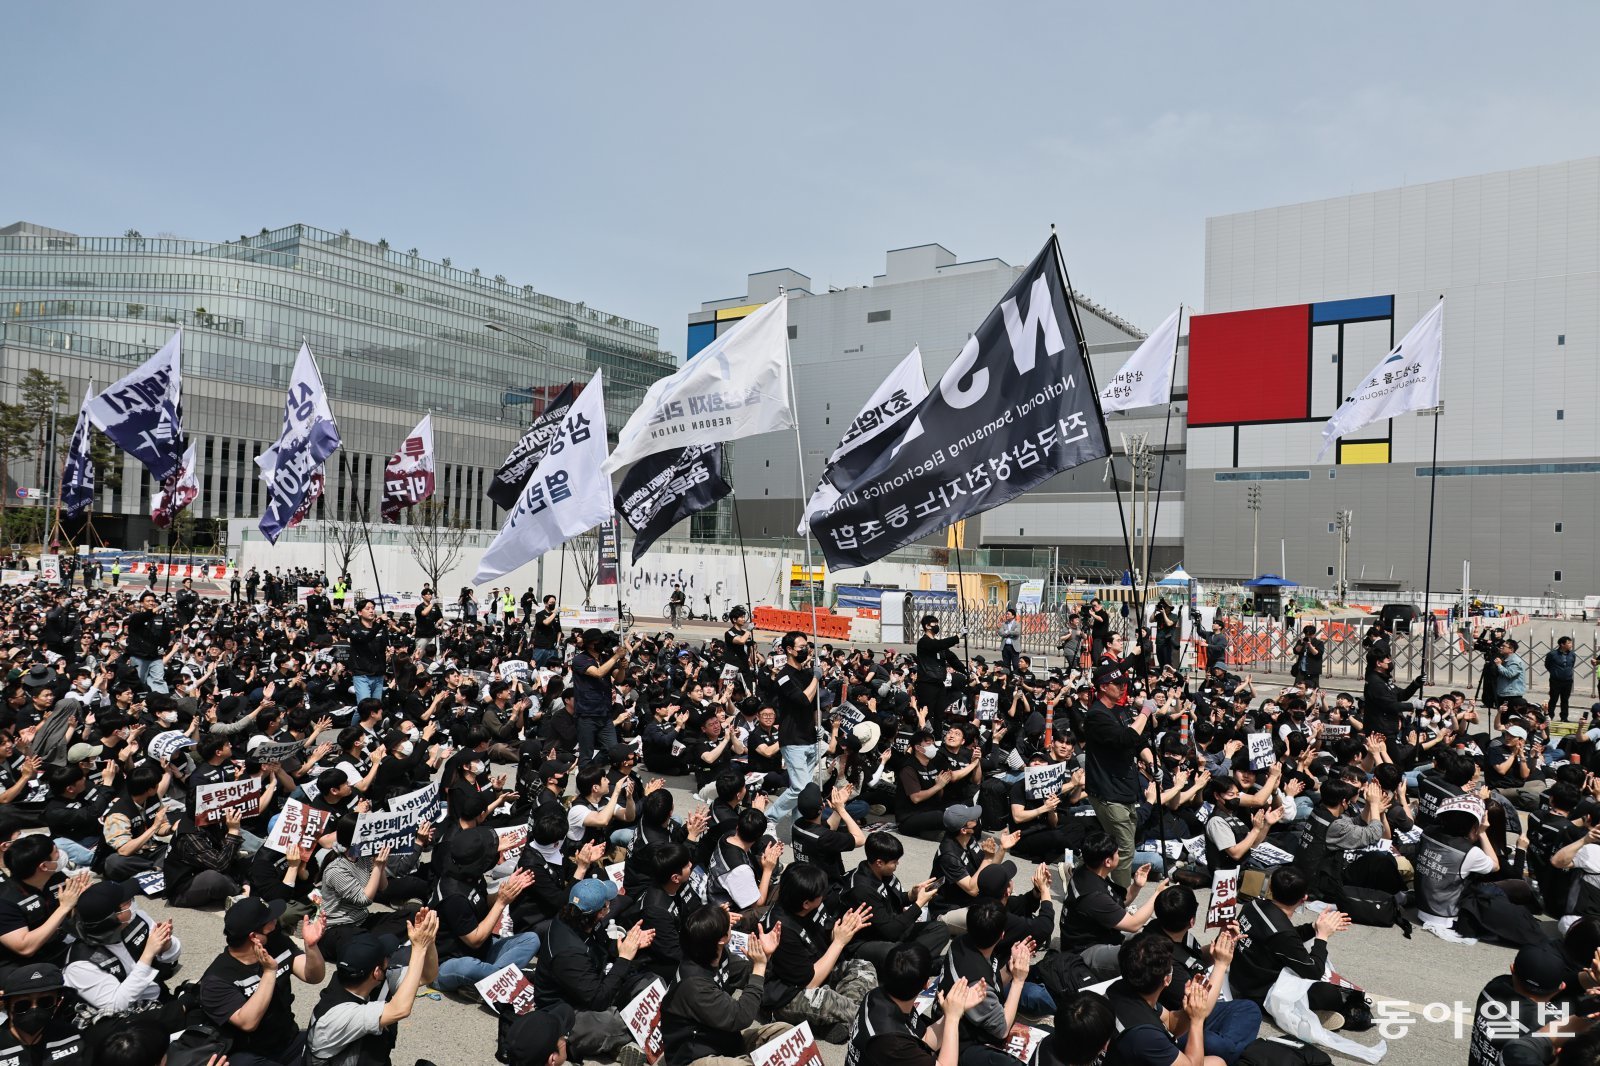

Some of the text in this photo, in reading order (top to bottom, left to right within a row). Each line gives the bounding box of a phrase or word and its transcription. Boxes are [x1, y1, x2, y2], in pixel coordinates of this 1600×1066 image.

[1028, 765, 1063, 785] 상한폐지
[201, 779, 255, 805] 투명하게
[277, 804, 299, 847] 투명하게
[301, 807, 322, 849] 바꾸고!!!
[359, 812, 413, 837] 상한폐지
[360, 833, 415, 857] 실현하자
[485, 967, 518, 1004] 투명하게
[629, 985, 661, 1035] 투명하게
